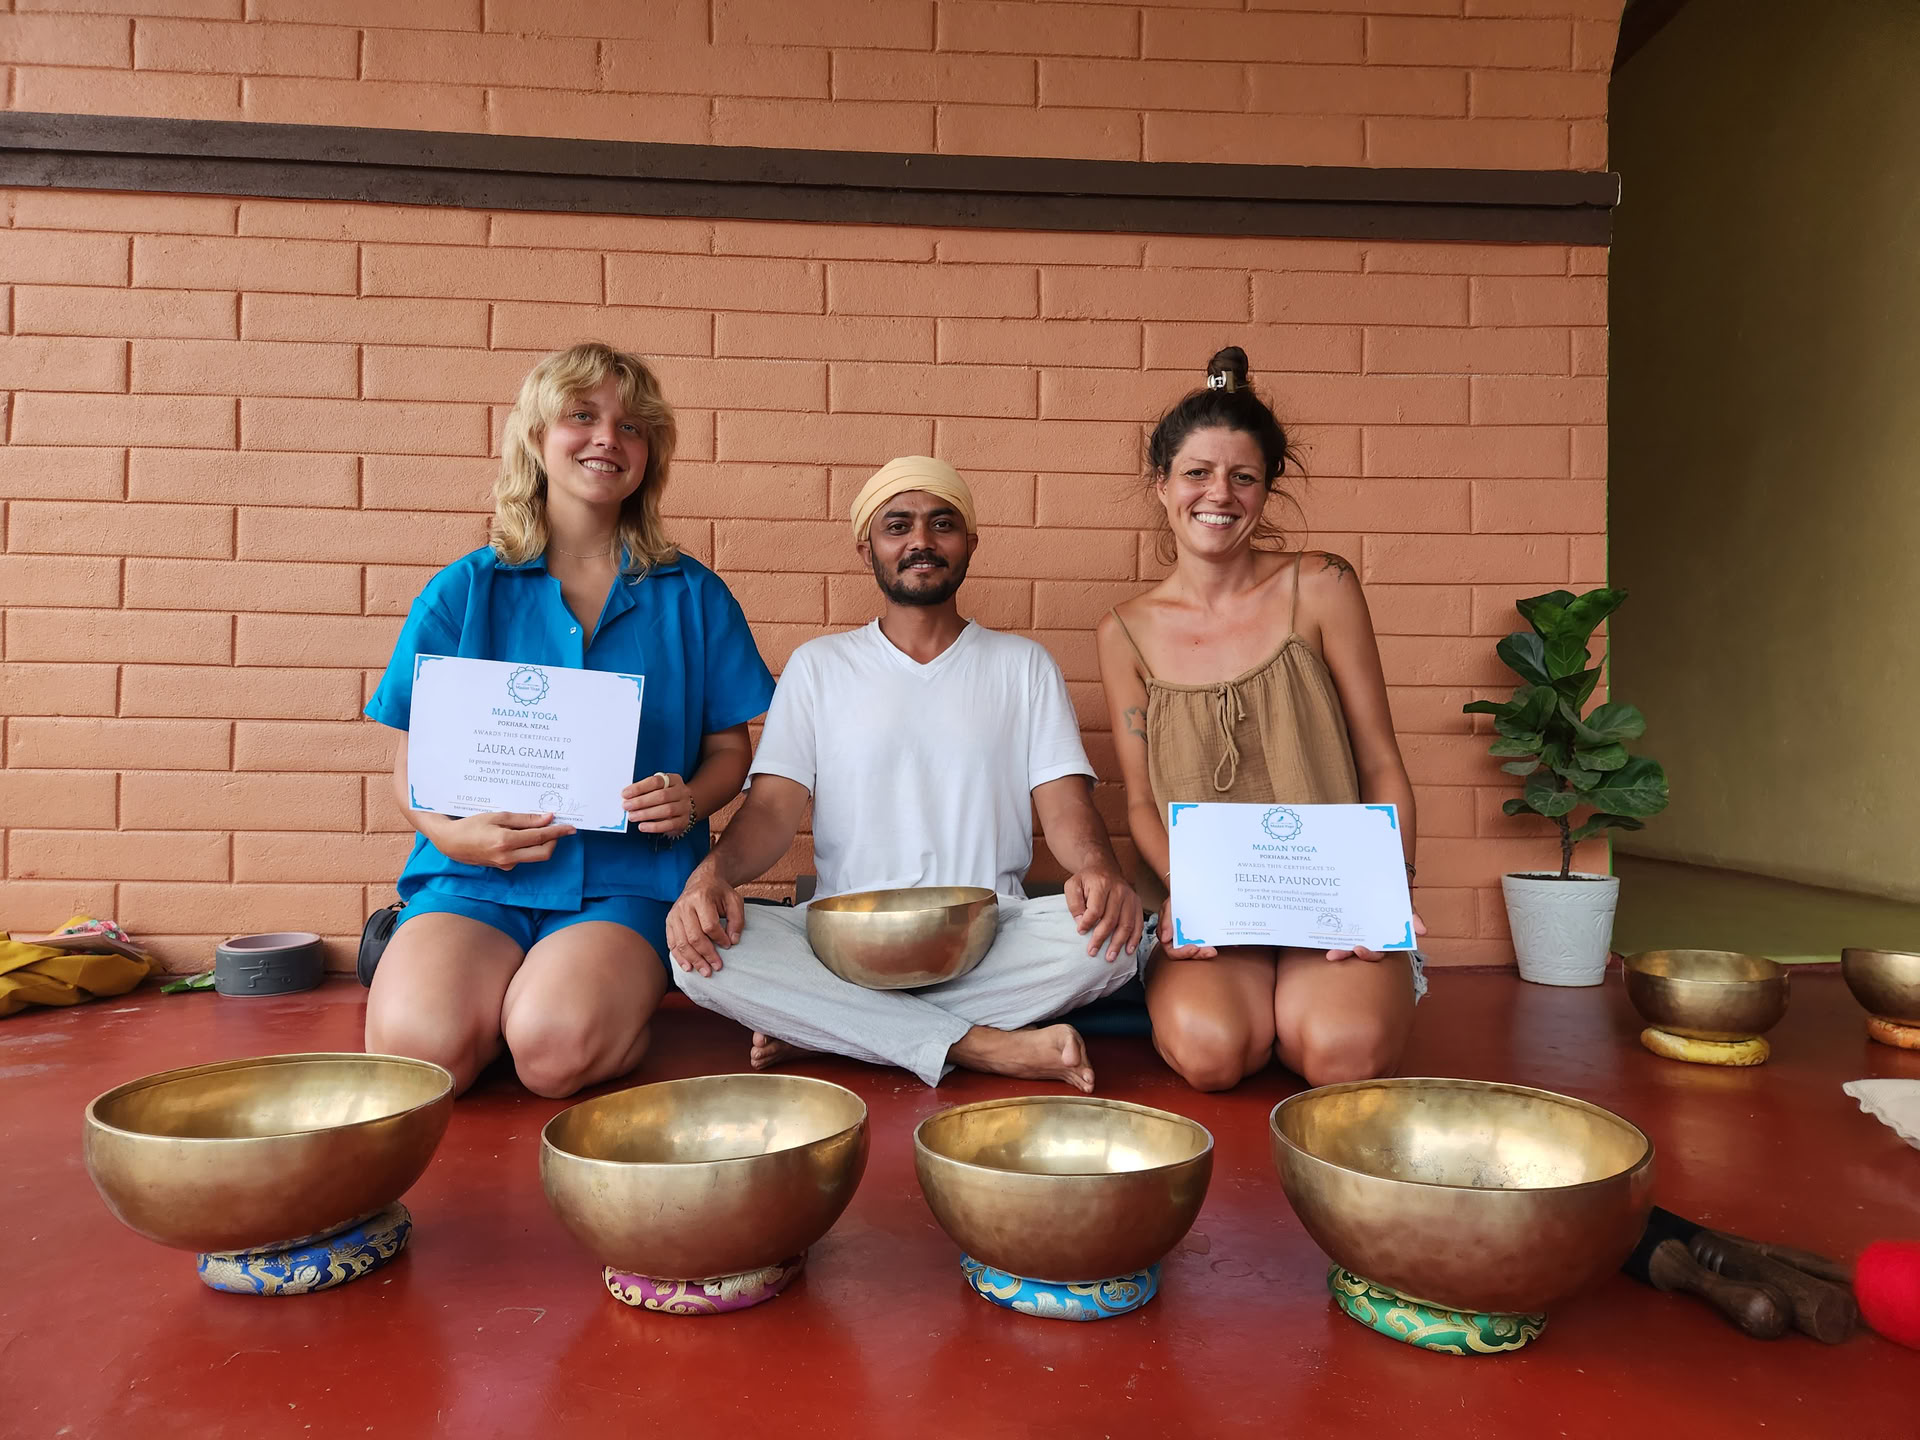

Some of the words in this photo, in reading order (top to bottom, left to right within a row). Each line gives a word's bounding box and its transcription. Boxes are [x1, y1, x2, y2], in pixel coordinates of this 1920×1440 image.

[492, 708, 528, 718] MADAN
[532, 711, 558, 721] YOGA
[520, 734, 560, 742] CERTIFICATE
[477, 743, 515, 756] LAURA
[518, 747, 565, 760] GRAMM
[531, 764, 561, 772] completion
[502, 769, 555, 779] FOUNDATIONAL
[542, 782, 569, 790] COURSE
[1252, 844, 1288, 852] MADAN
[1235, 873, 1276, 883] JELENA
[1279, 876, 1341, 887] PAUNOVIC
[1272, 896, 1327, 905] FOUNDATIONAL
[1283, 904, 1314, 912] HEALING
